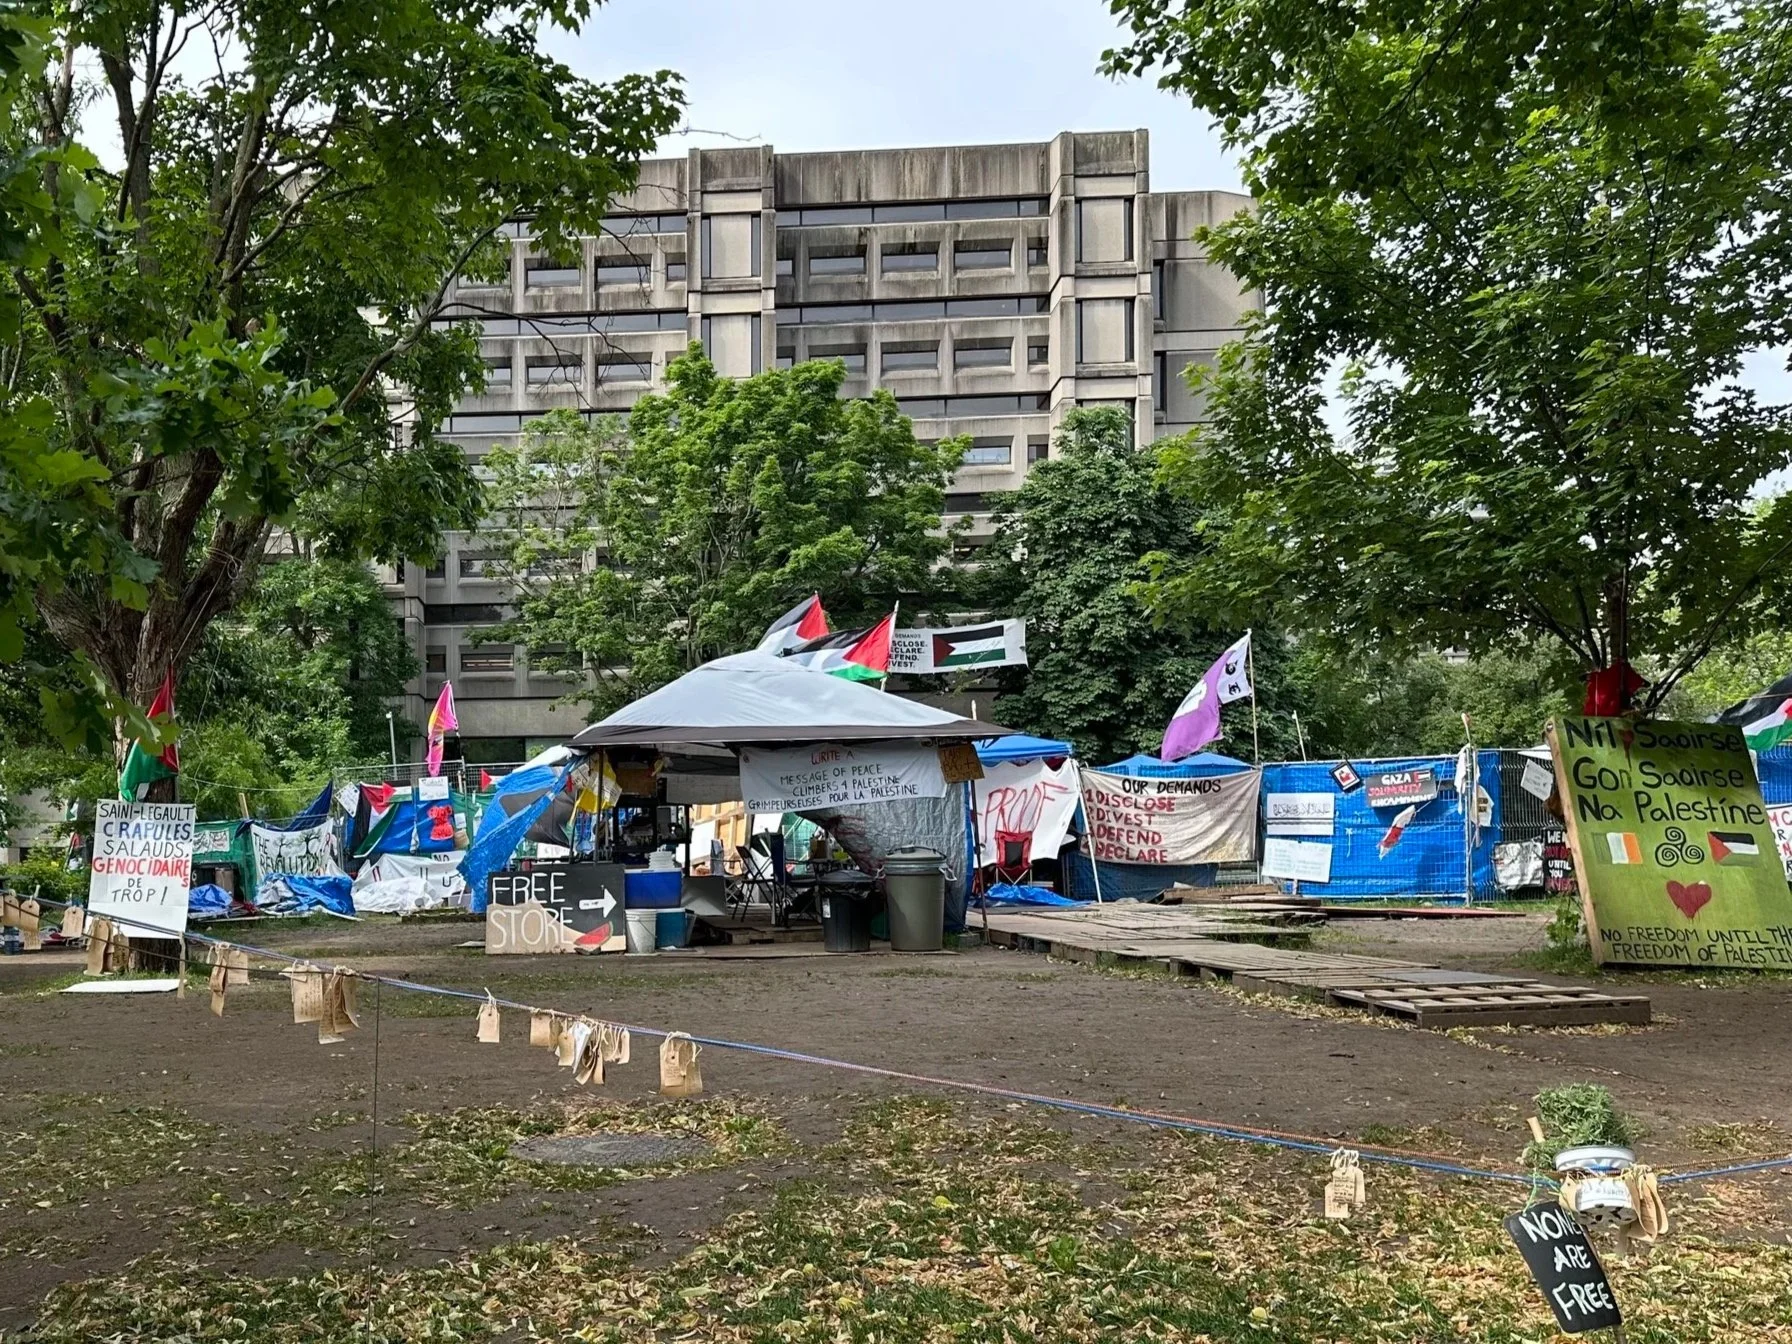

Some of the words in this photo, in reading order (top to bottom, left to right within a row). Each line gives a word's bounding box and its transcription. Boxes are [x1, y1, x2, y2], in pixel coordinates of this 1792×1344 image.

[890, 647, 925, 655] ECLARE.
[891, 640, 929, 648] SCLOSE.
[887, 660, 916, 668] IVEST.
[888, 653, 920, 662] EFEND.
[1633, 720, 1742, 751] Saoirse
[811, 751, 841, 766] WRITE
[846, 750, 855, 760] A
[780, 772, 828, 785] MESSAGE
[832, 767, 847, 778] OF
[852, 764, 882, 775] PEACE
[1381, 772, 1412, 786] GAZA
[1571, 756, 1632, 791] Gon
[1638, 760, 1745, 790] Saoirse
[792, 783, 838, 797] CLIMBERS
[842, 782, 848, 790] 4
[852, 775, 901, 789] PALESTINE
[829, 791, 849, 802] POUR
[854, 790, 865, 800] LA
[870, 784, 918, 798] PALESTINE
[1122, 778, 1150, 794] OUR
[1156, 778, 1222, 795] DEMANDS
[1096, 790, 1177, 812] DISCLOSE
[1577, 794, 1624, 823] Na
[1096, 807, 1156, 827] DIVEST
[103, 822, 193, 843] CRAPULES,
[1096, 824, 1162, 846] DEFEND
[102, 840, 189, 859] SALAUDS,
[252, 832, 270, 855] THE
[1095, 841, 1169, 864] DECLARE
[127, 877, 142, 889] DE
[492, 872, 567, 906] FREE
[490, 907, 574, 948] STORE
[1601, 928, 1622, 943] NO
[1627, 926, 1700, 943] FREEDOM
[1707, 928, 1769, 944] UNTIL
[1612, 943, 1692, 960] FREEDOM
[1697, 945, 1719, 962] OF
[1553, 1244, 1592, 1273] ARE
[1551, 1281, 1614, 1321] FREE
